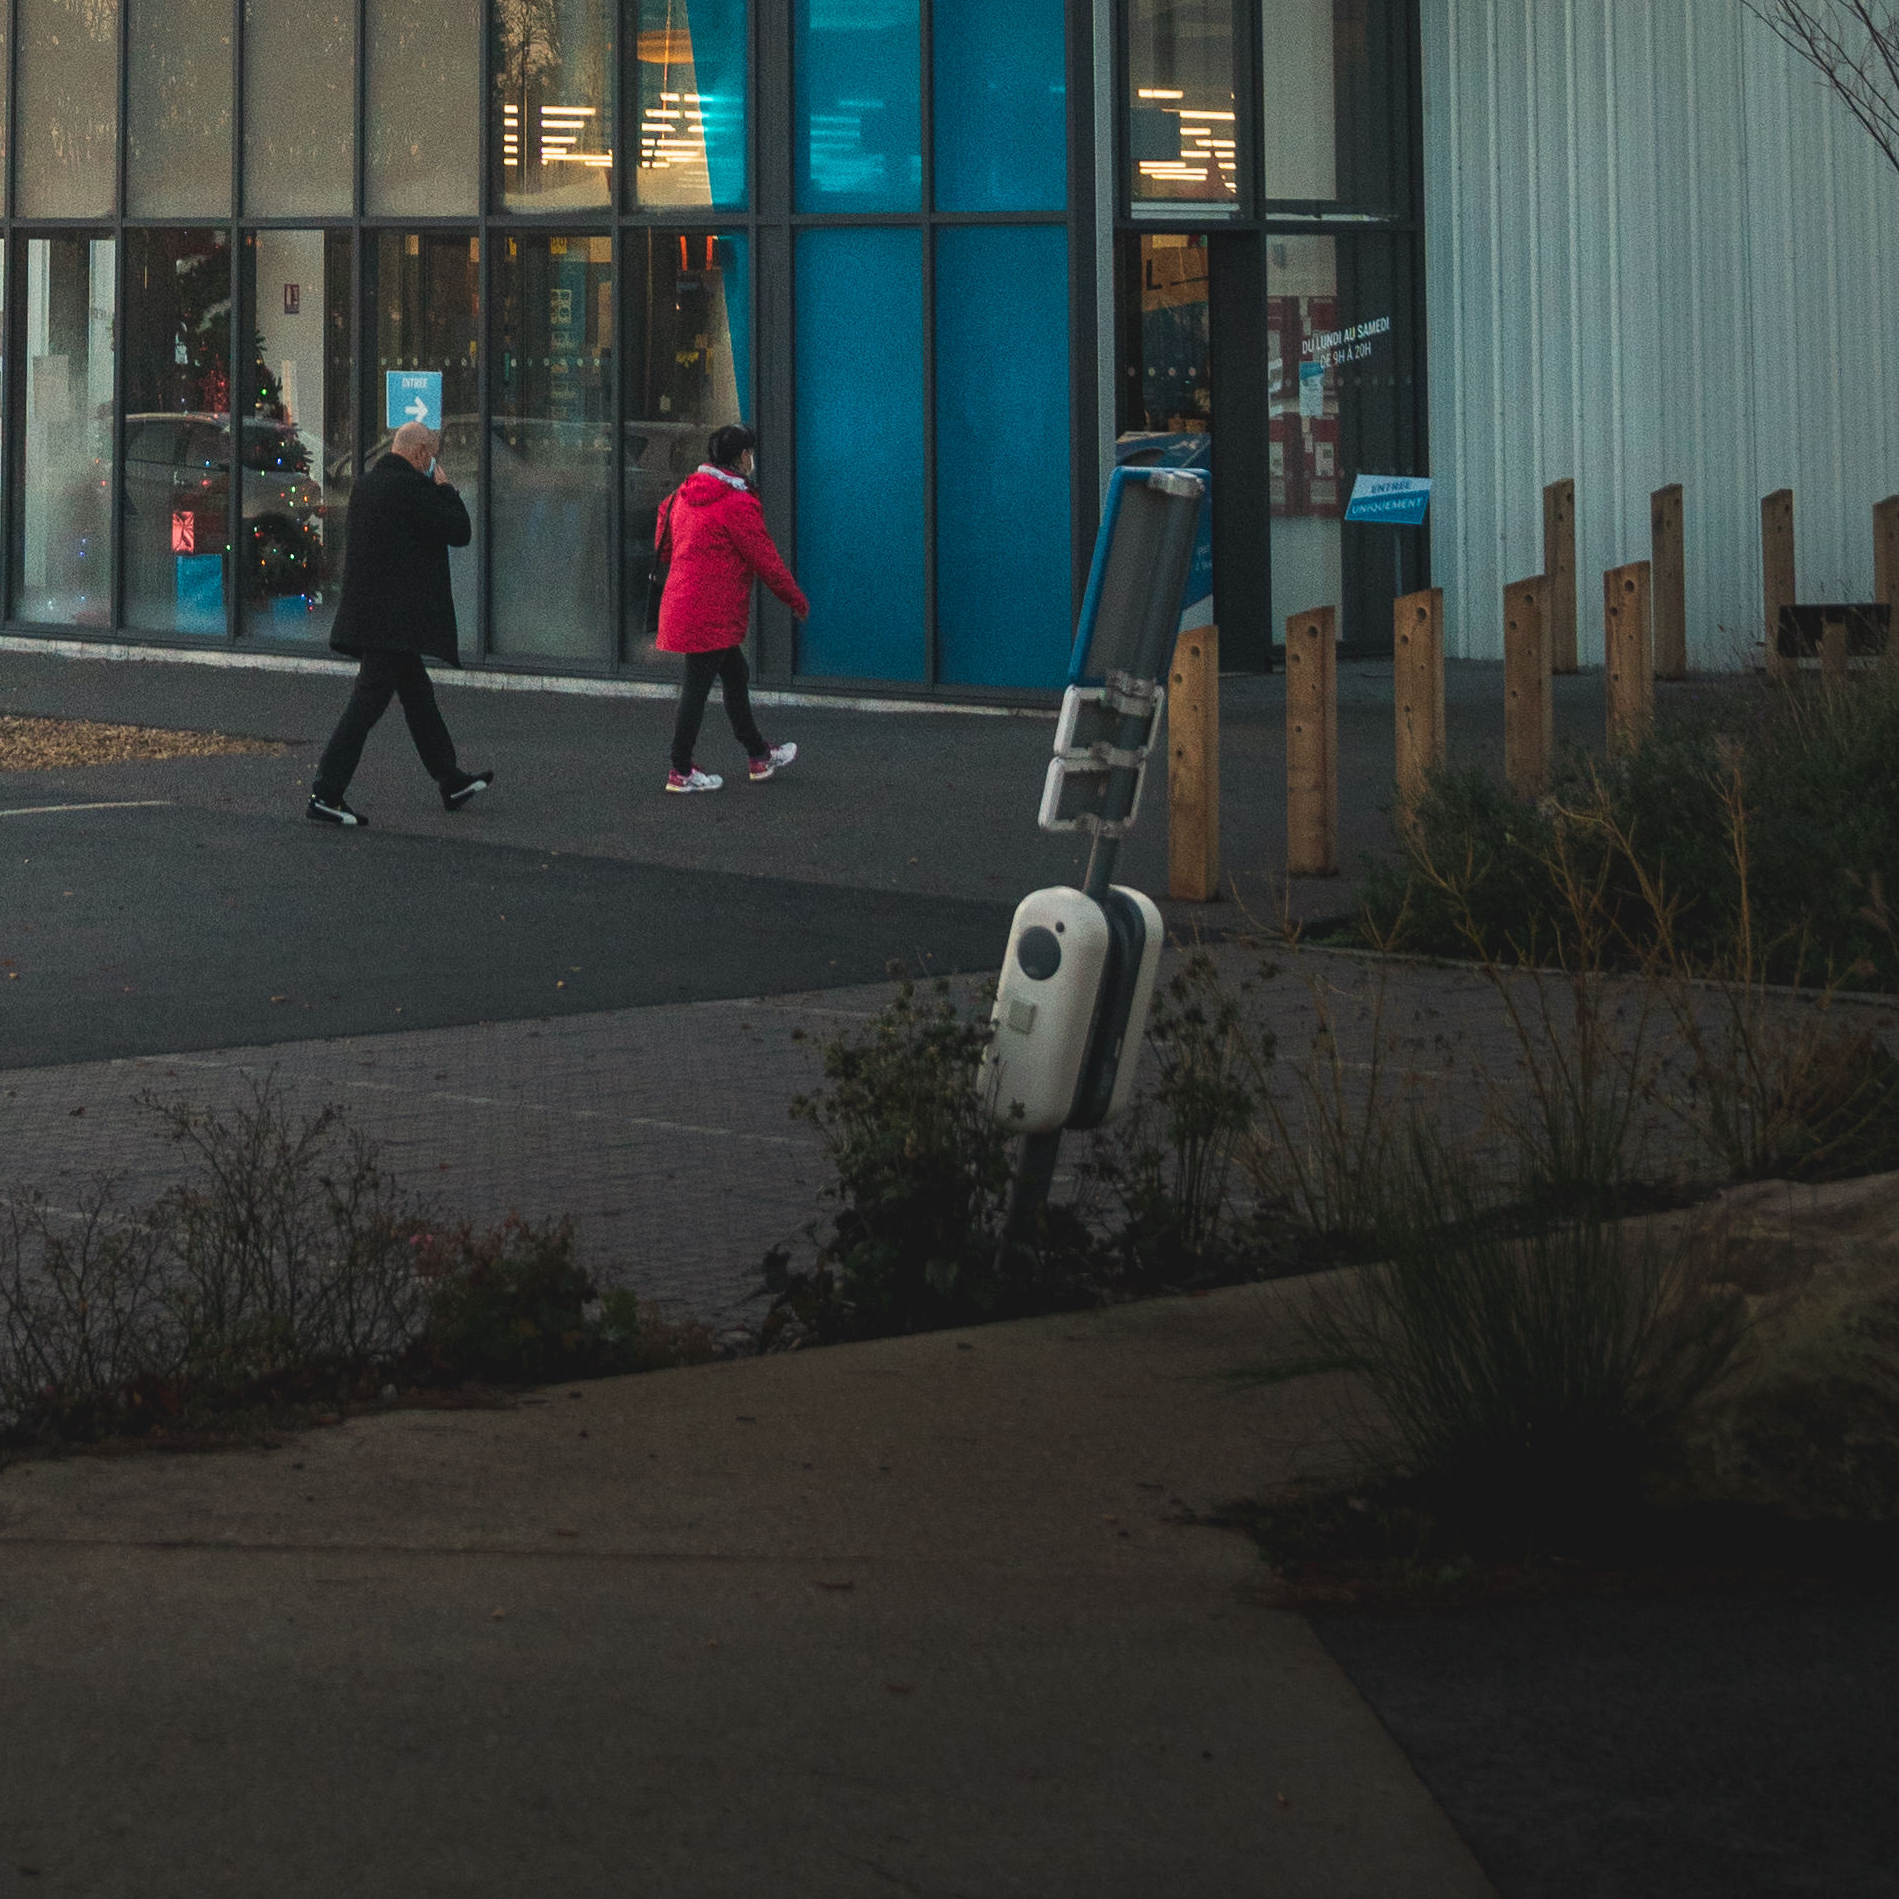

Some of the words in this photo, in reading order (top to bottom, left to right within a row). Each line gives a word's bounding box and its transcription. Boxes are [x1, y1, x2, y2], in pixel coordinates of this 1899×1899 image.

[1302, 339, 1315, 354] DU
[1316, 330, 1342, 350] LUNDI
[1344, 326, 1356, 343] AU
[1357, 316, 1390, 339] SAMEDI
[1320, 352, 1331, 369] DE
[1332, 349, 1345, 365] 9H
[1354, 341, 1372, 359] 20H
[1352, 497, 1423, 514] UNIQUEMENT
